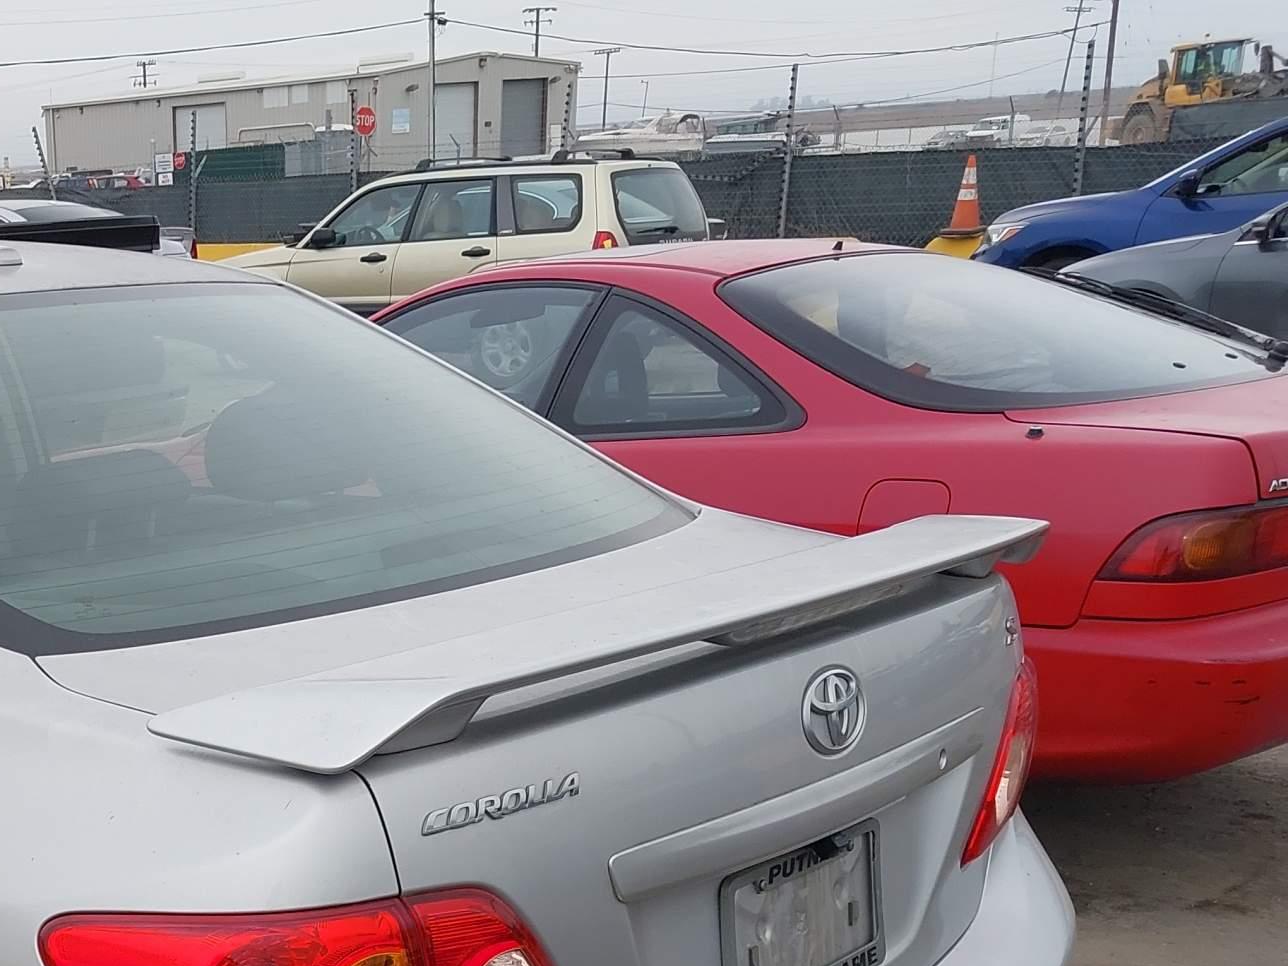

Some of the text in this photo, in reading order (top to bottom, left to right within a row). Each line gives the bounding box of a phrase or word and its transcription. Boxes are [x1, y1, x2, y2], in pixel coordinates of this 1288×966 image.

[356, 114, 375, 127] STOP
[421, 771, 580, 836] COROLLA
[768, 848, 820, 885] PUTN
